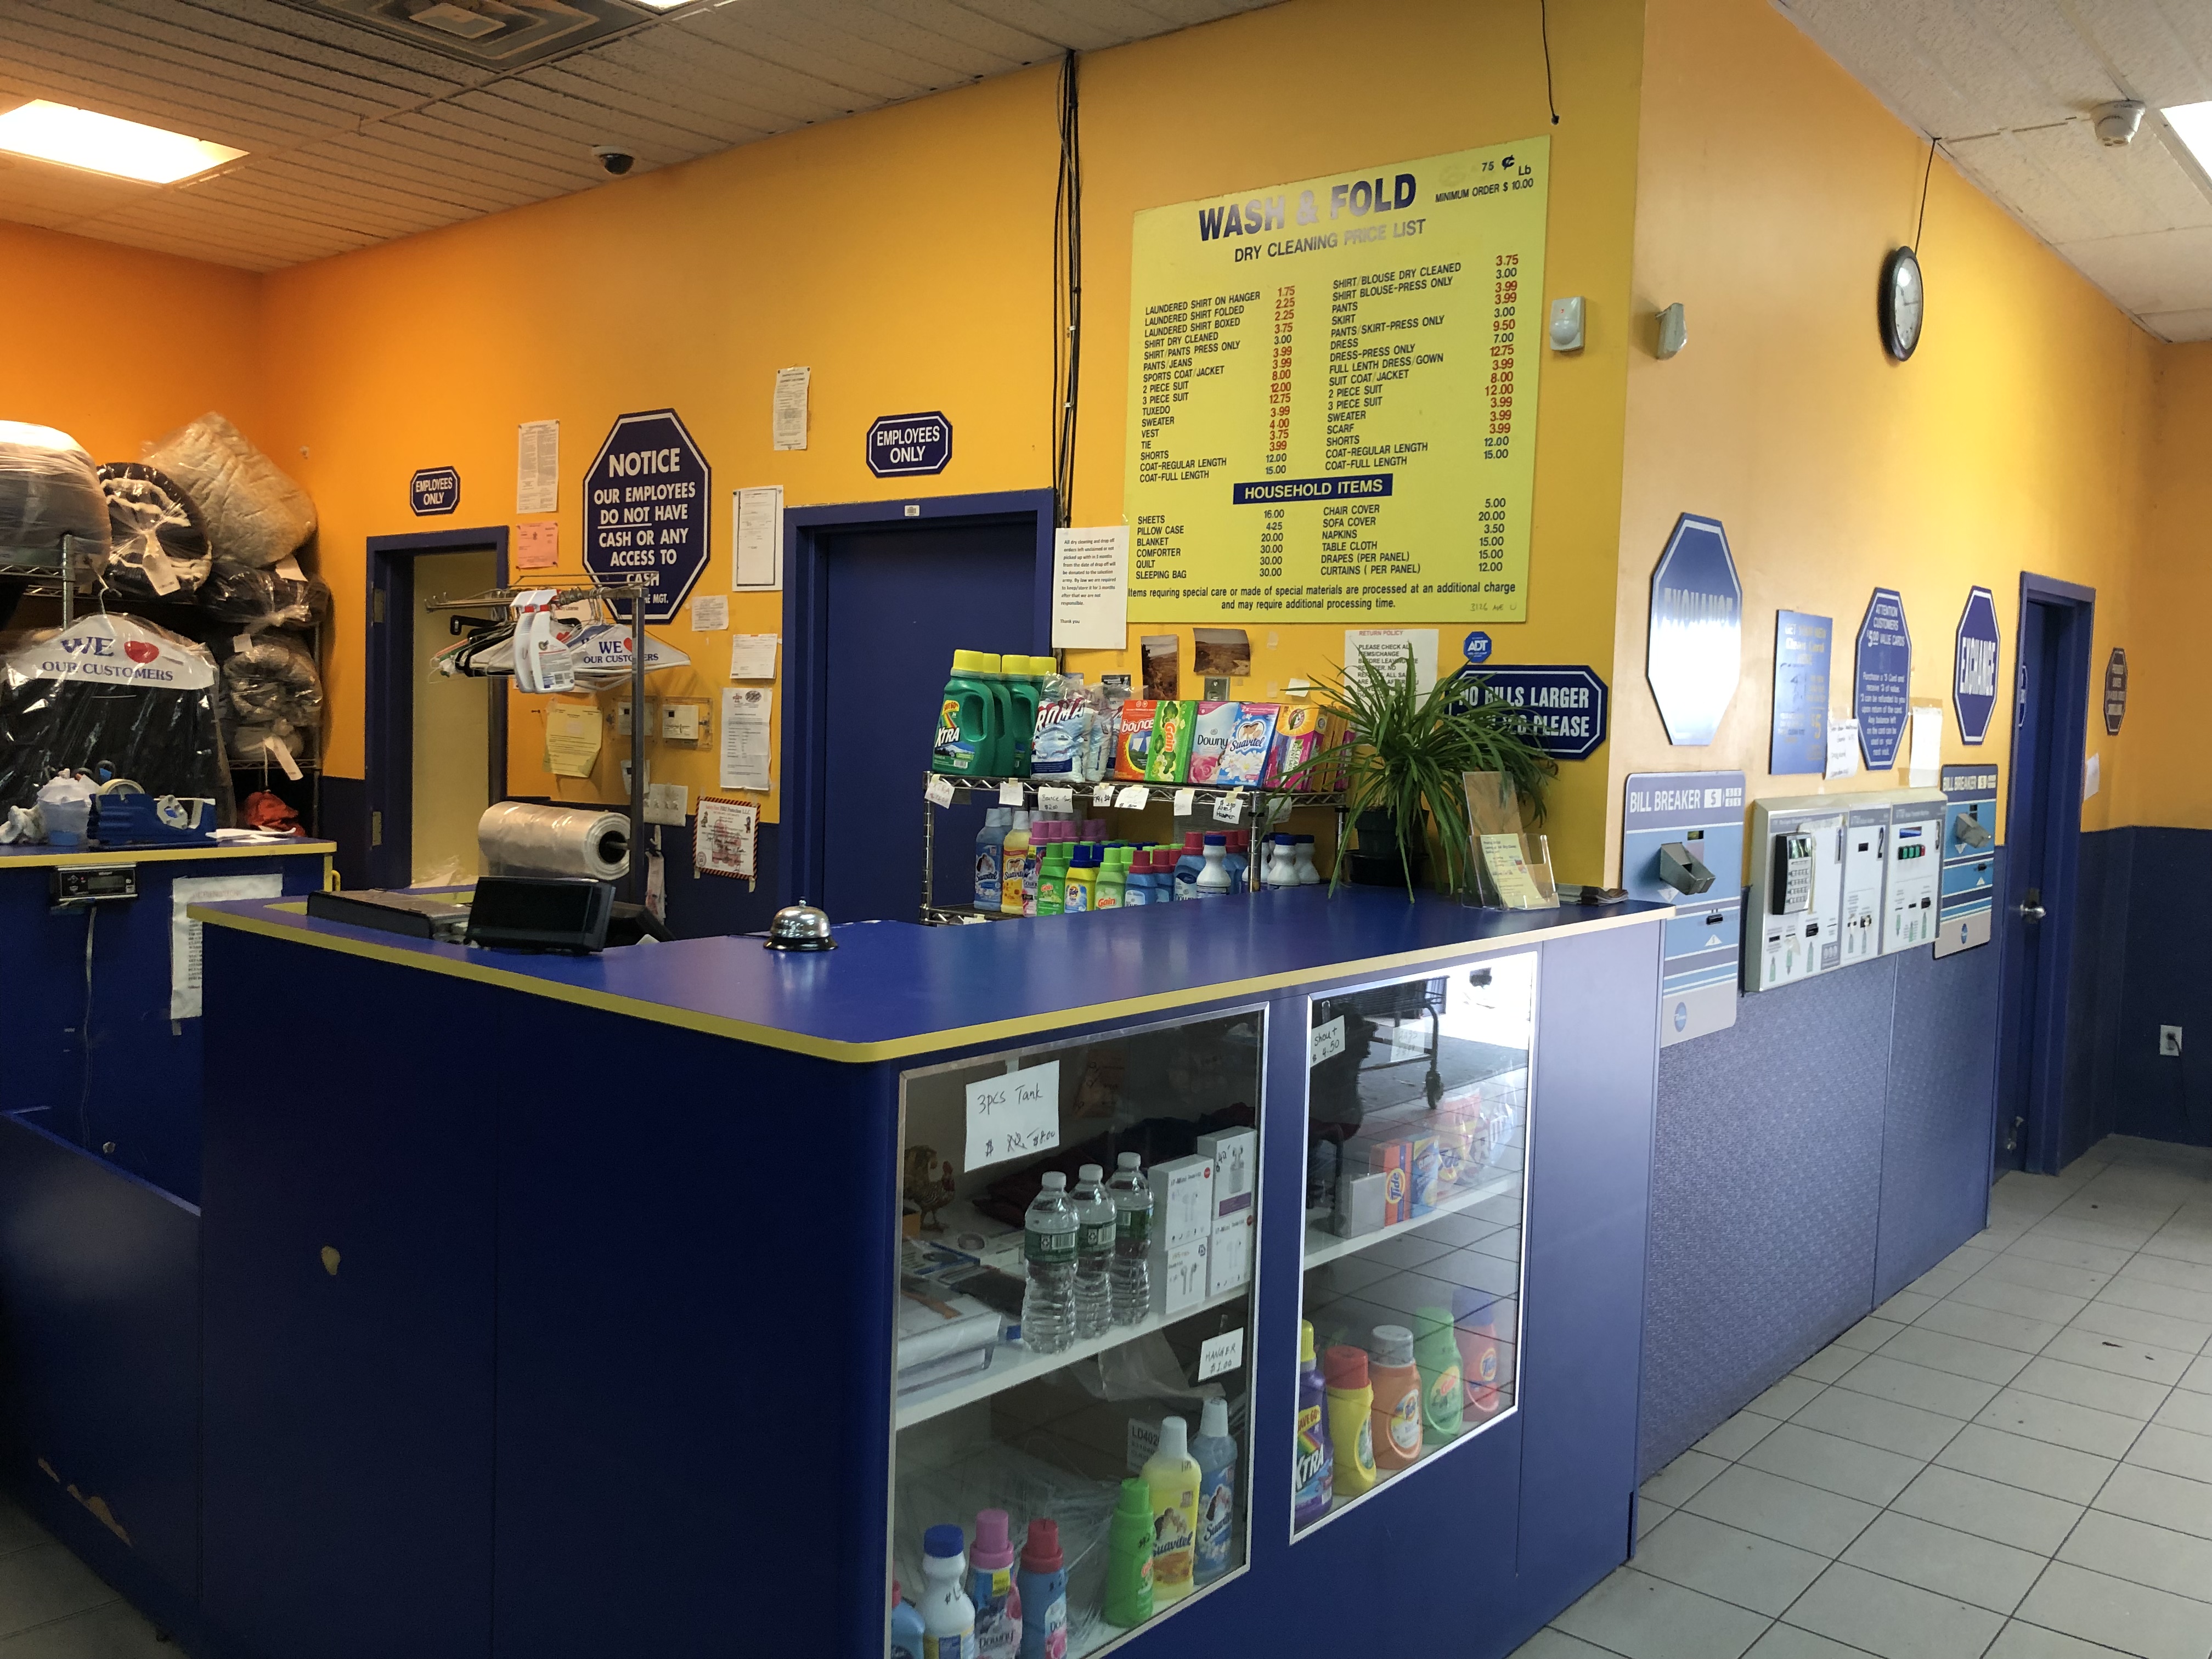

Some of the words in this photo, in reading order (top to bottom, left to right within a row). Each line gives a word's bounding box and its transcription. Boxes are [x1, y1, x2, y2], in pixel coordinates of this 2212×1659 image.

[1482, 161, 1494, 172] 75
[1518, 164, 1531, 176] Lb
[1435, 188, 1469, 202] MINIMUM
[1471, 183, 1499, 196] ORDER
[1502, 182, 1508, 191] $
[1511, 178, 1533, 190] 10.00
[1199, 193, 1284, 241] WASH
[1296, 190, 1319, 225] &
[1330, 173, 1417, 218] FOLD
[1234, 245, 1262, 263] DRY
[1267, 233, 1338, 257] CLEANING
[1344, 223, 1387, 246] PRICE
[1393, 218, 1426, 239] LIST
[1145, 301, 1188, 315] LAUNDERED
[1190, 297, 1212, 309] SHIRT
[1215, 296, 1226, 306] ON
[1228, 291, 1260, 303] HANGER
[1277, 285, 1295, 297] 1.75
[1144, 313, 1187, 326] LAUNDERED
[1190, 309, 1211, 320] SHIRT
[1214, 305, 1244, 317] FOLDED
[1275, 297, 1295, 309] 2.25
[1144, 324, 1187, 337] LAUNDERED
[1190, 320, 1211, 331] SHIRT
[1214, 317, 1240, 328] BOXED
[1274, 308, 1294, 321] 2.25
[1144, 338, 1164, 349] SHIRT
[1167, 336, 1182, 346] DRY
[1184, 331, 1218, 343] CLEANED
[1274, 322, 1293, 334] 3.75
[1144, 347, 1190, 360] SHIRT/PANTS
[1194, 342, 1218, 354] PRESS
[1221, 340, 1240, 351] ONLY
[1274, 334, 1291, 345] 3.00
[1143, 357, 1192, 371] PANTS/JEANS
[1273, 345, 1292, 358] 3.99
[1143, 371, 1171, 382] SPORTS
[1174, 365, 1224, 379] COAT/JACKET
[1272, 357, 1291, 369] 3.99
[1143, 385, 1147, 393] 2
[1149, 382, 1170, 393] PIECE
[1172, 380, 1189, 390] SUIT
[1272, 369, 1291, 381] 8.00
[1142, 396, 1147, 405] 3
[1149, 394, 1170, 404] PIECE
[1172, 392, 1189, 402] SUIT
[1270, 381, 1291, 393] 12.00
[1142, 405, 1170, 415] TUXEDO
[1269, 392, 1290, 404] 12.75
[1141, 416, 1174, 427] SWEATER
[1270, 405, 1290, 417] 3.99
[877, 426, 940, 447] EMPLOYEES
[1141, 428, 1159, 438] VEST
[1269, 417, 1289, 429] 4.00
[1141, 440, 1151, 449] TIE
[1269, 428, 1289, 440] 3.75
[890, 445, 926, 464] ONLY
[1140, 450, 1169, 460] SHORTS
[1269, 440, 1286, 452] 3.99
[609, 447, 680, 477] NOTICE
[1139, 459, 1195, 471] COAT-REGULAR
[1198, 457, 1226, 467] LENGTH
[1266, 453, 1286, 462] 12.00
[1139, 472, 1178, 482] COAT-FULL
[1181, 470, 1209, 479] LENGTH
[1265, 465, 1286, 475] 15.00
[416, 477, 453, 493] EMPLOYEES
[594, 488, 620, 505] OUR
[625, 482, 696, 503] EMPLOYEES
[1244, 482, 1332, 500] HOUSEHOLD
[1338, 478, 1383, 495] ITEMS
[423, 492, 445, 505] ONLY
[600, 509, 619, 524] DO
[624, 506, 650, 523] NOT
[654, 504, 688, 521] HAVE
[599, 531, 631, 548] CASH
[636, 529, 655, 546] OR
[660, 527, 689, 544] ANY
[610, 550, 655, 567] ACCESS
[659, 549, 677, 565] TO
[627, 573, 659, 586] CASH
[653, 594, 669, 603] MGT.
[60, 636, 114, 657] WE
[599, 641, 623, 654] WE
[1467, 640, 1488, 651] ADT
[583, 654, 603, 664] OUR
[42, 661, 77, 676] OUR
[83, 662, 174, 682] CUSTOMERS
[1530, 687, 1589, 708] LARGER
[1034, 697, 1086, 735] ROMA
[1533, 715, 1589, 737] PLEASE
[934, 726, 960, 747] XTRA
[1164, 721, 1176, 753] Gain
[1197, 734, 1229, 749] Downy
[1229, 736, 1266, 753] Suavitel
[1629, 791, 1652, 813] BILL
[1654, 788, 1701, 812] BREAKER
[1040, 884, 1054, 892] Gain
[1098, 898, 1116, 907] Gain
[1322, 1039, 1340, 1058] 4.50
[1014, 1082, 1043, 1105] Tank
[1390, 1172, 1402, 1200] Tide
